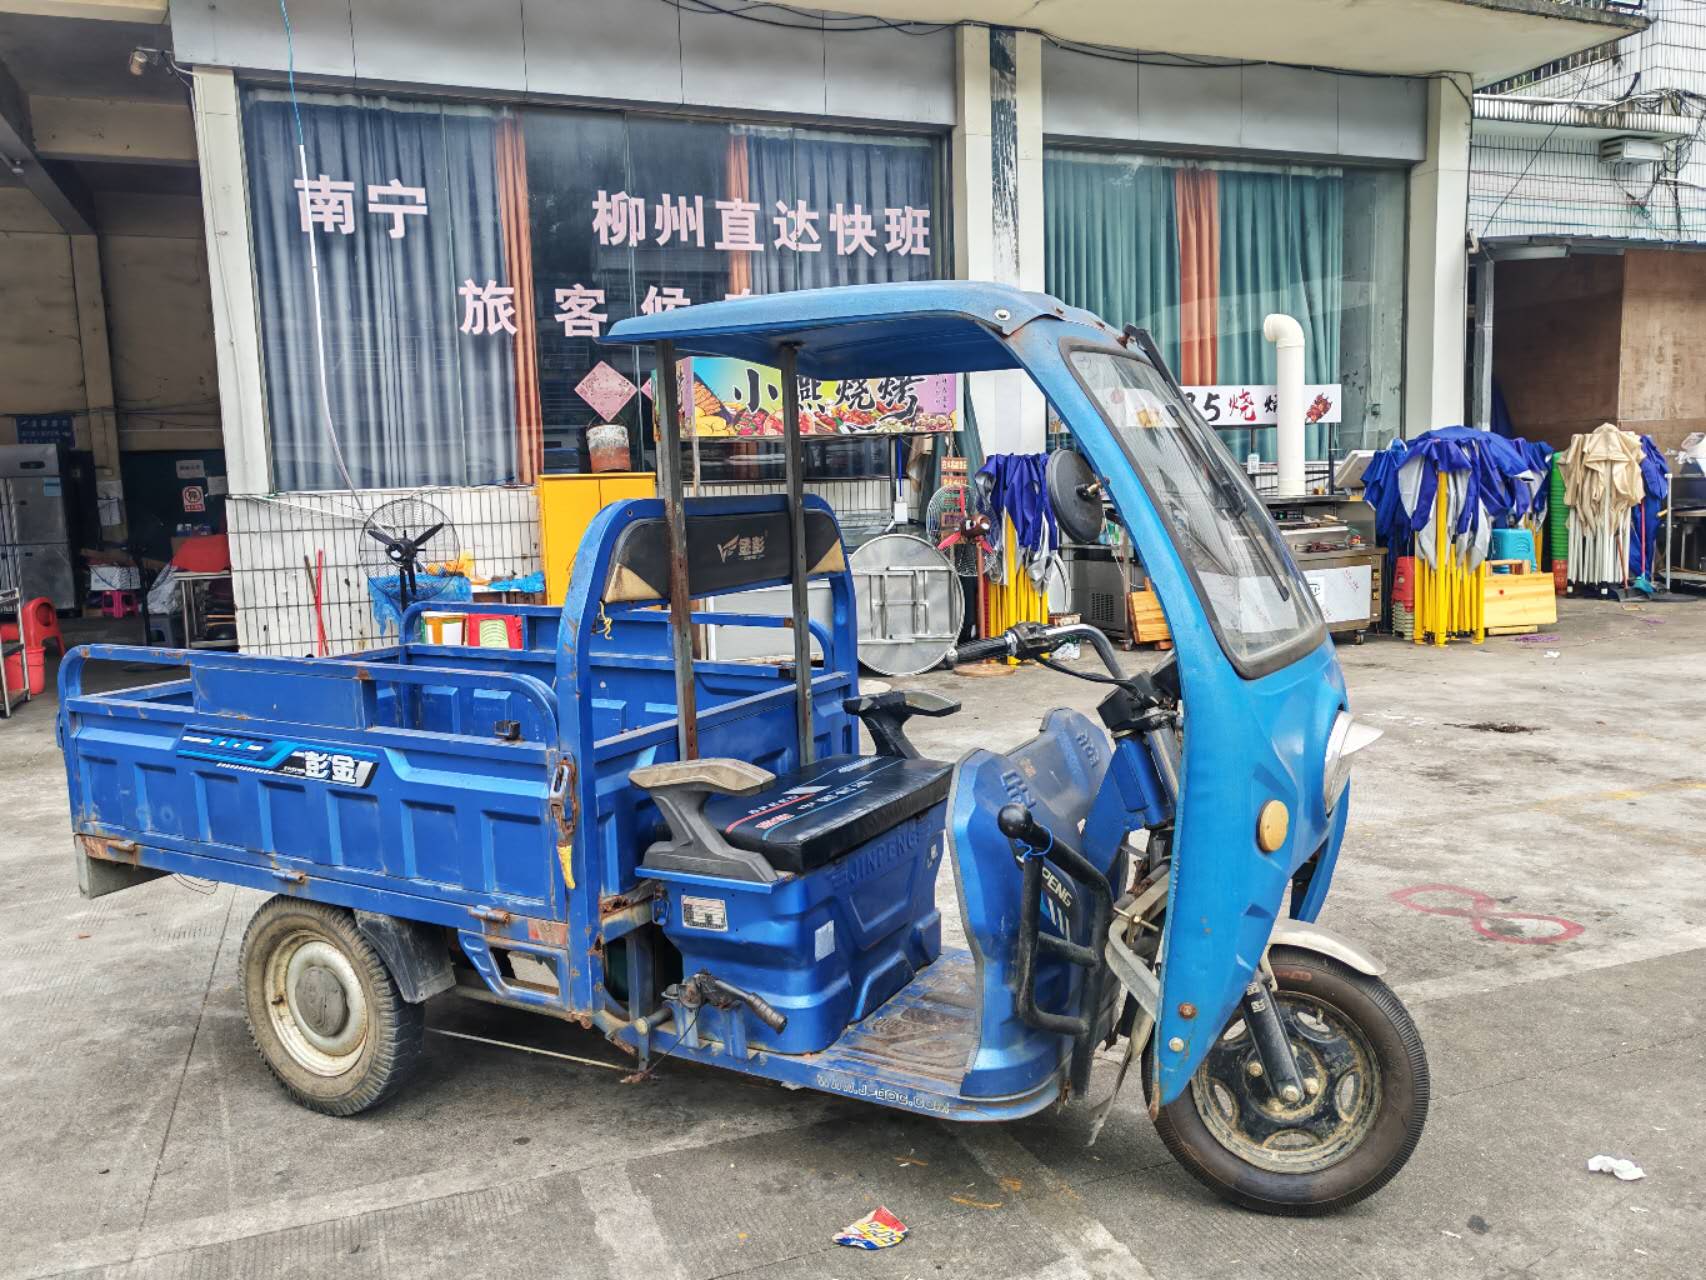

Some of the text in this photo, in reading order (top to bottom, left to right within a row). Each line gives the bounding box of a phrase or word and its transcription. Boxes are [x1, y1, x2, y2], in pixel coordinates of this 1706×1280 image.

[294, 174, 931, 257] 南宁 柳州直达快班
